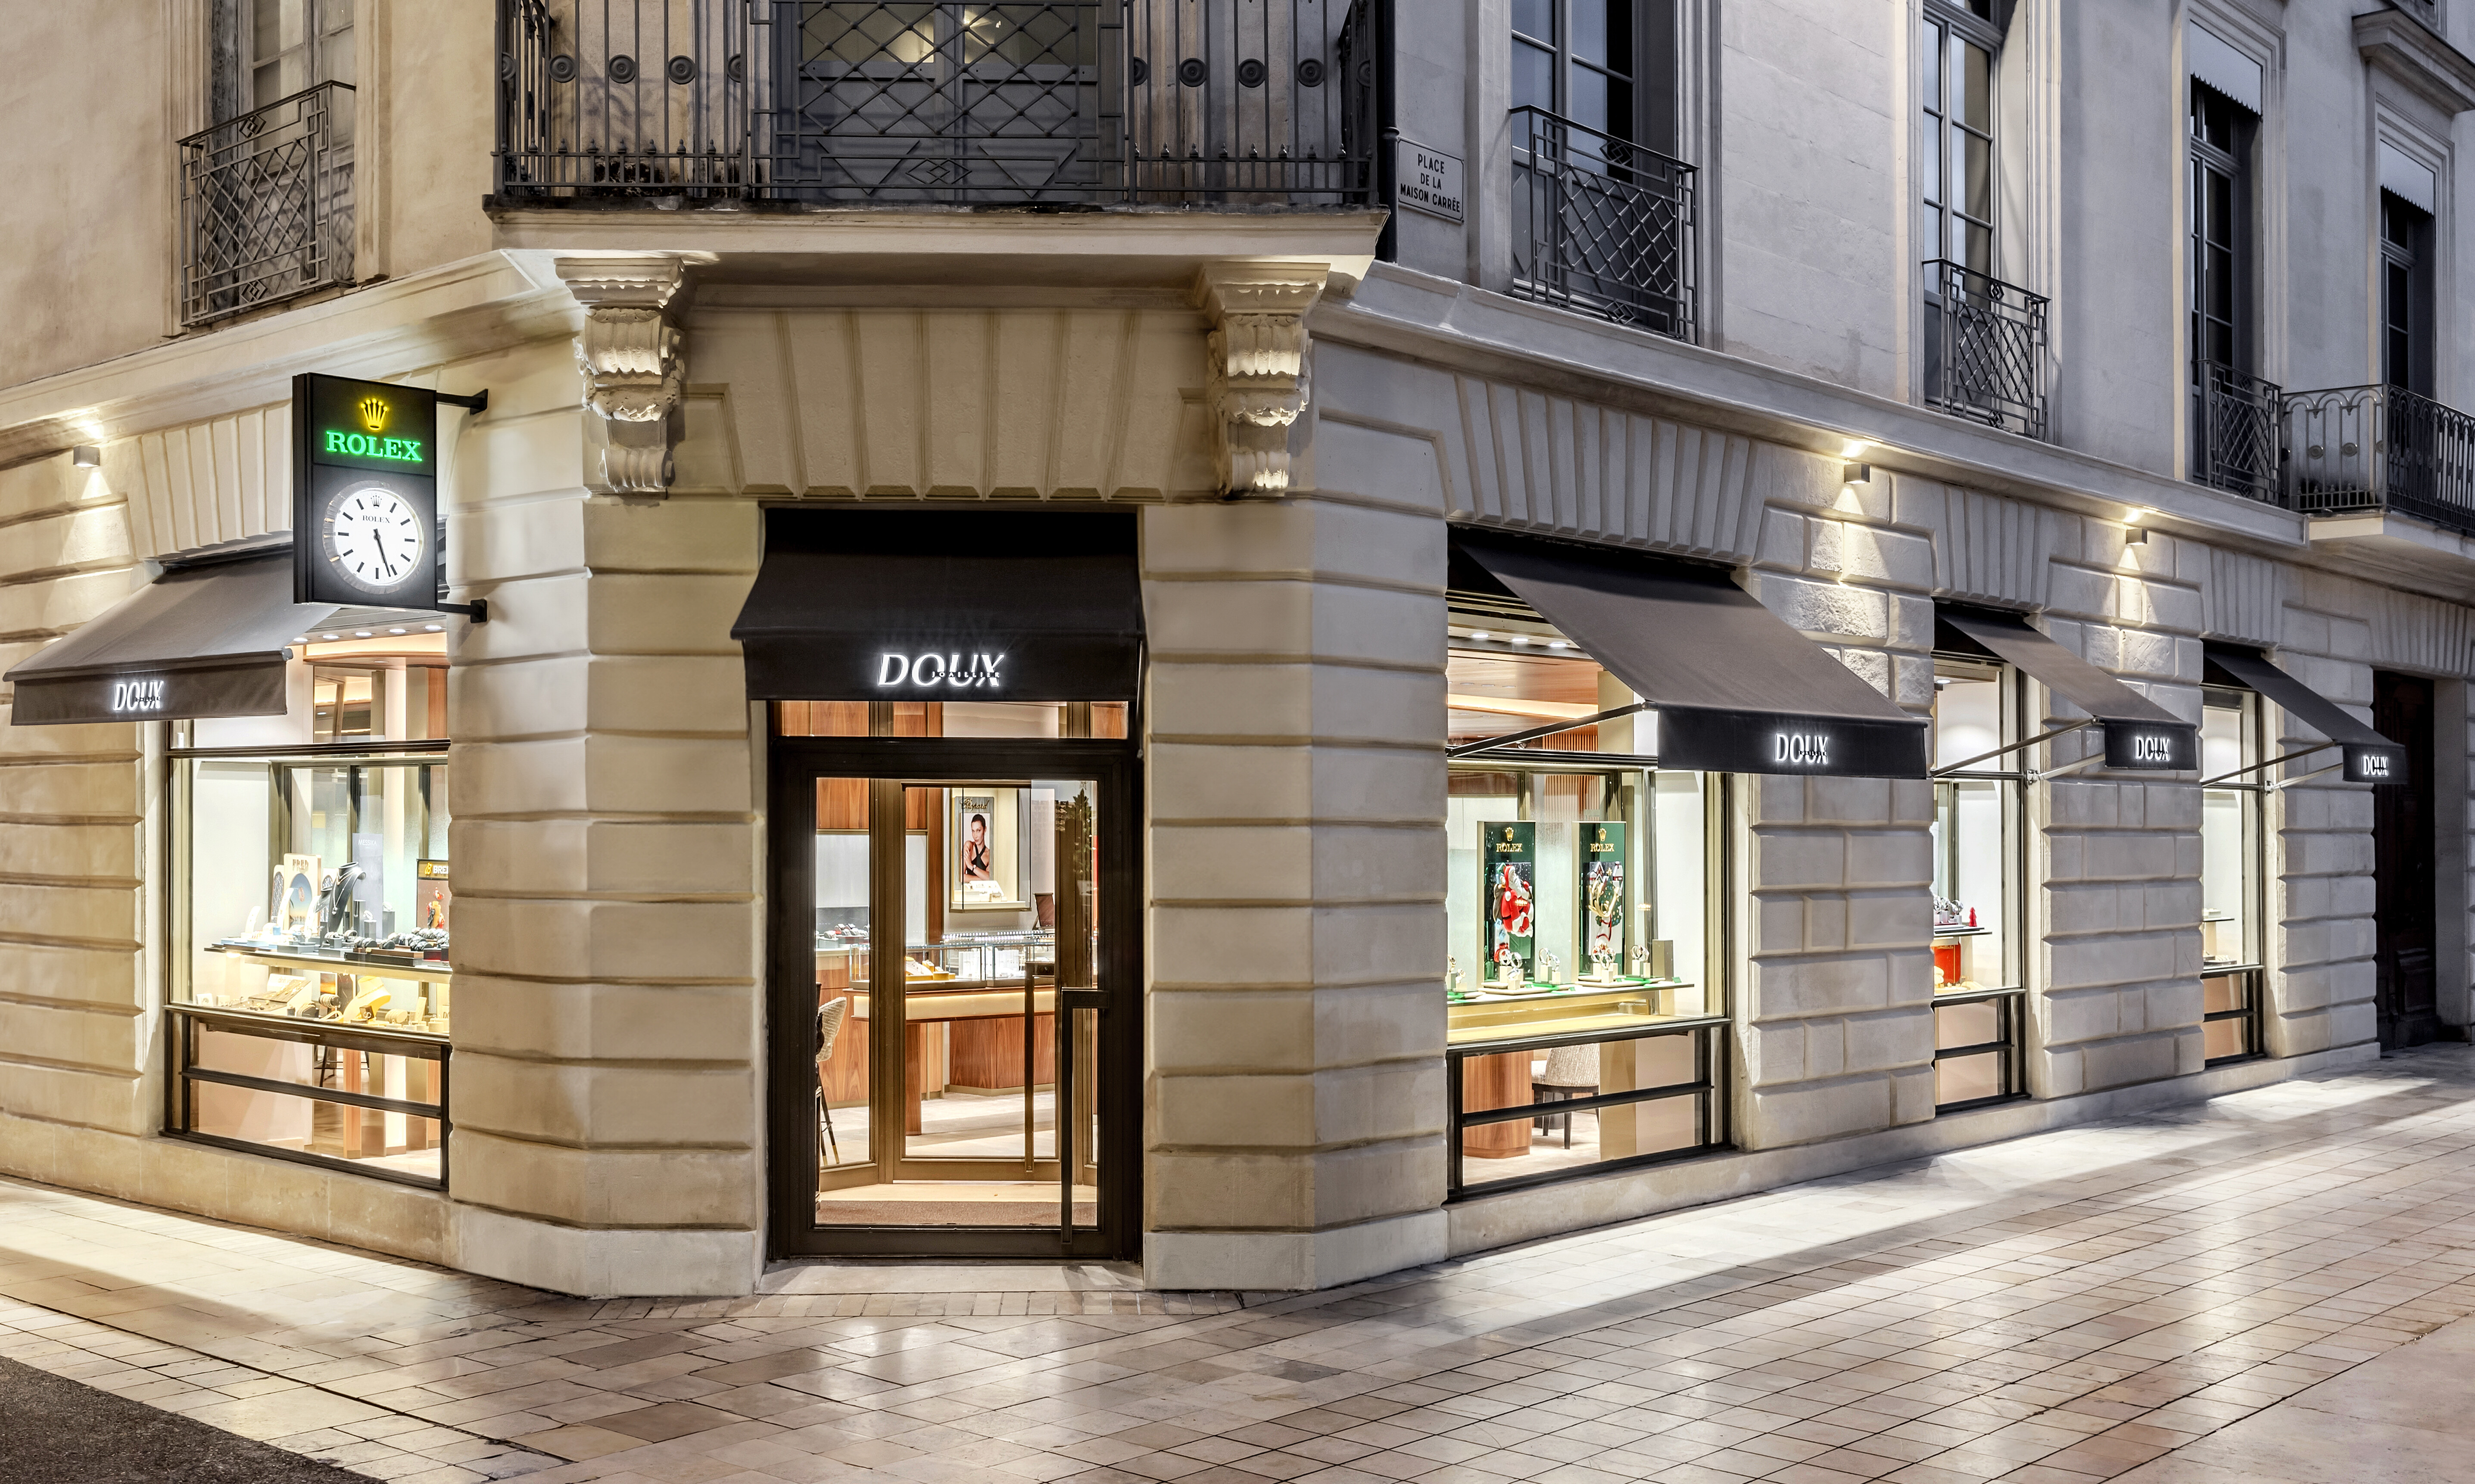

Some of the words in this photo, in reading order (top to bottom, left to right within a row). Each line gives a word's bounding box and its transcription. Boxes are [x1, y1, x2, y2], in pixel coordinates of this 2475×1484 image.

[1418, 153, 1444, 174] PLACE
[1421, 173, 1429, 186] DE
[1433, 177, 1441, 190] LA
[1400, 183, 1428, 202] MAISON
[326, 431, 422, 461] ROLEX
[362, 515, 390, 523] ROLEX
[878, 653, 1004, 686] DOUX
[113, 681, 164, 710] DOUX
[1775, 734, 1829, 764] DOUX
[2135, 736, 2170, 761] DOUX
[2363, 755, 2388, 775] DOUX
[1496, 843, 1523, 852] ROLEX
[1590, 843, 1615, 852] ROLEX
